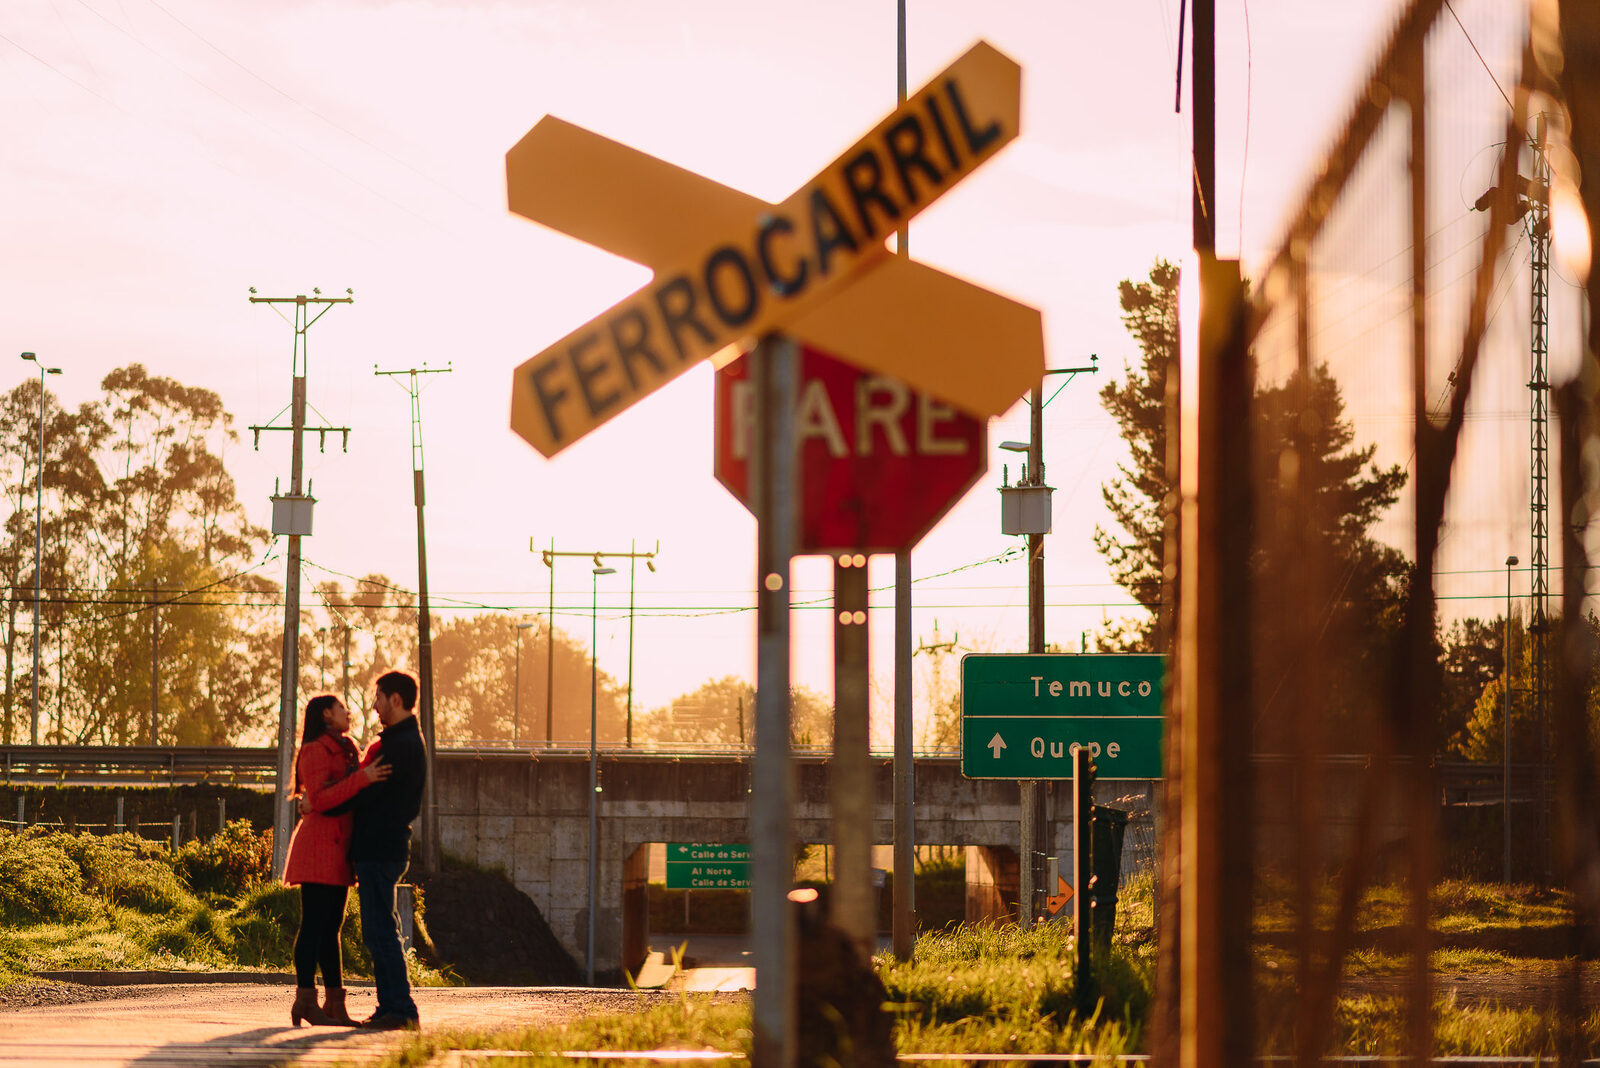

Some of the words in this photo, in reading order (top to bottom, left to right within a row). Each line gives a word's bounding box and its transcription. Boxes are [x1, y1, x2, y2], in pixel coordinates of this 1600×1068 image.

[527, 75, 1002, 443] FERROCARRIL
[1030, 676, 1152, 697] Temuco
[691, 851, 715, 859] Calle
[717, 851, 729, 859] de
[730, 851, 752, 859] Serv
[691, 867, 702, 875] Al
[706, 867, 732, 875] Norte
[691, 878, 715, 886] Calle
[717, 878, 728, 886] de
[730, 878, 752, 886] Serv
